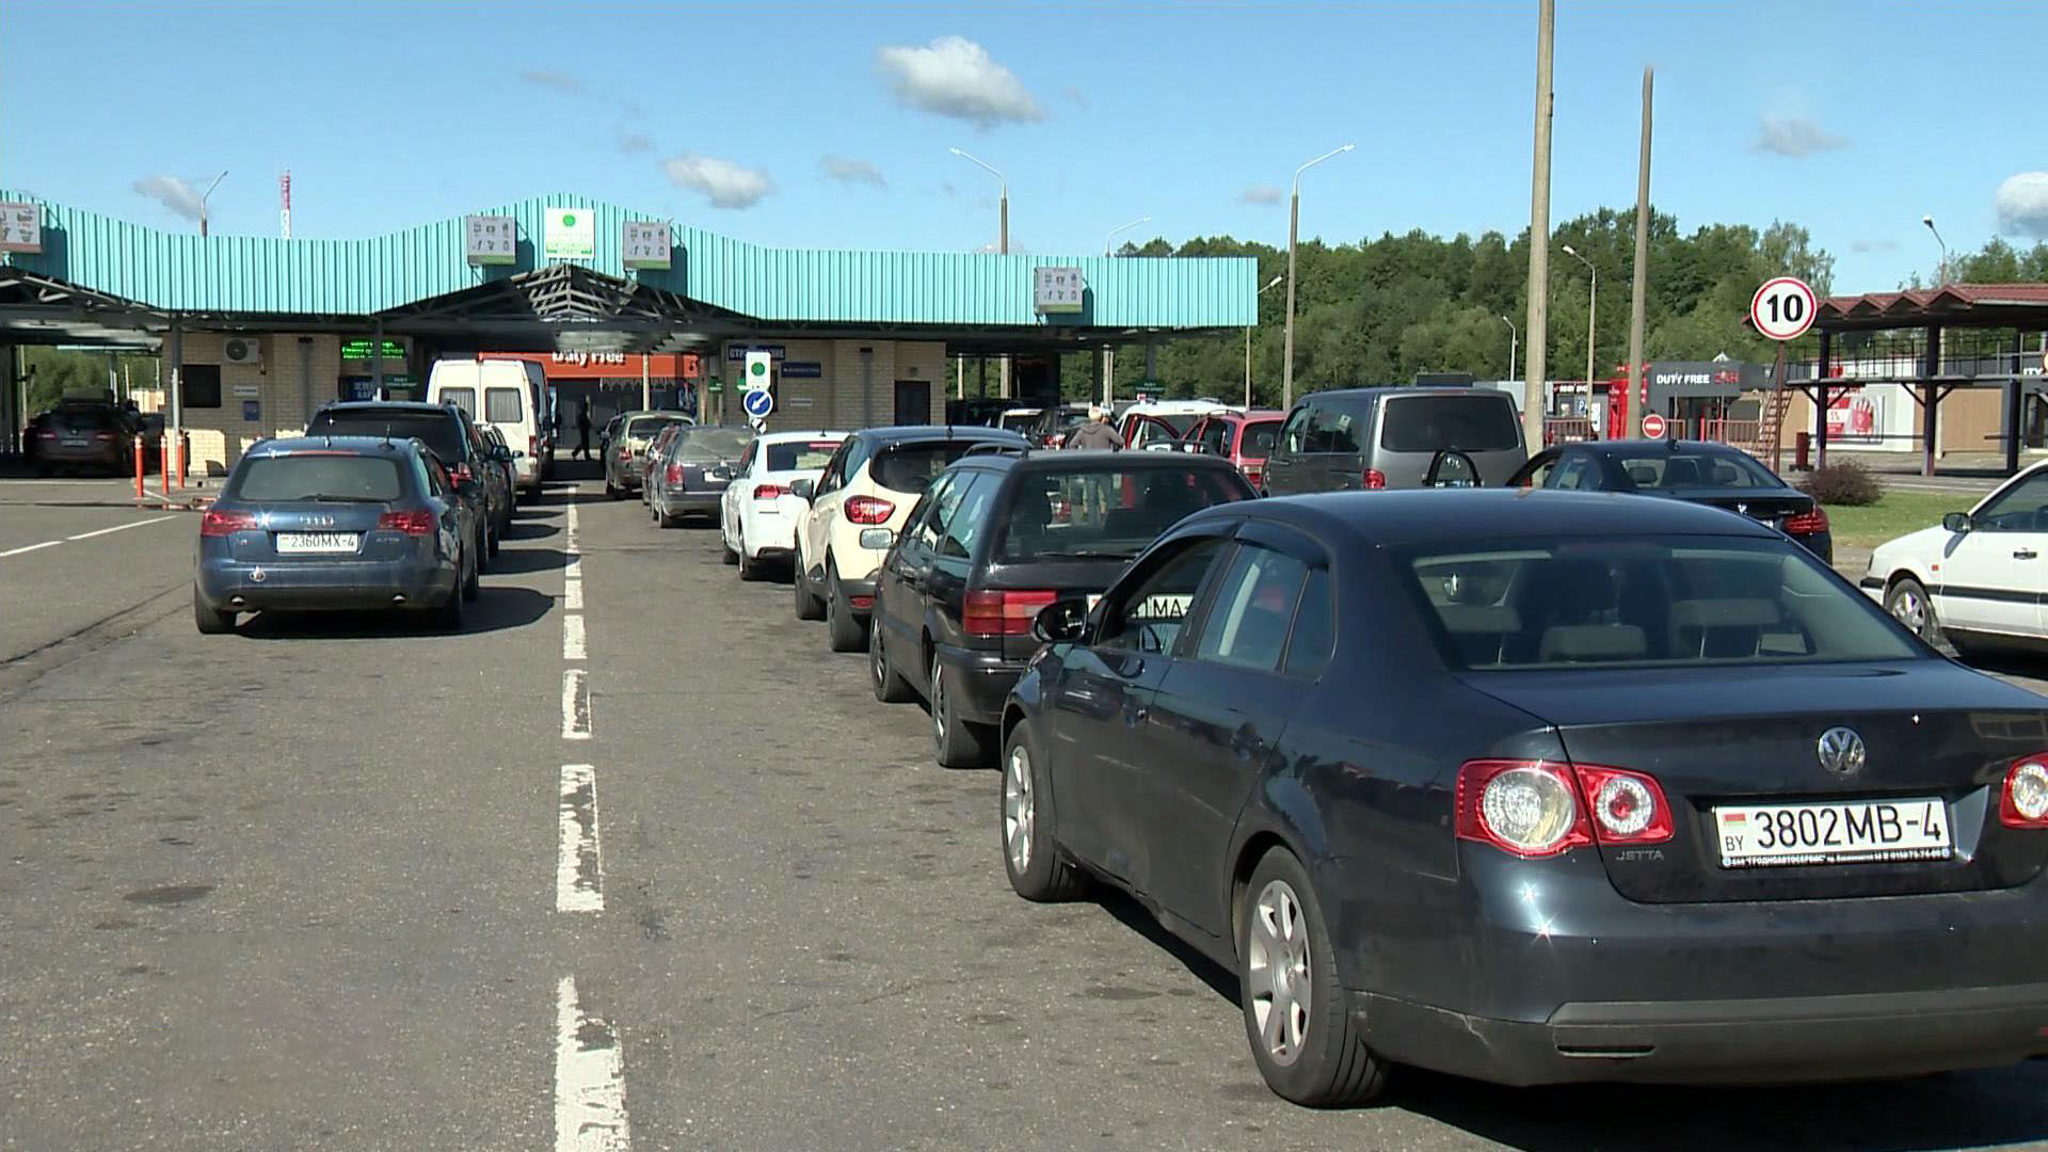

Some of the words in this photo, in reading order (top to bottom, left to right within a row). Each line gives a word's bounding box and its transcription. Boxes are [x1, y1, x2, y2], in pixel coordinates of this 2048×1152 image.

[1767, 294, 1804, 323] 10
[1656, 374, 1682, 384] DUTY
[1684, 374, 1710, 384] FREE
[290, 532, 355, 548] 2360MX-4
[1754, 803, 1942, 849] 3802MB-4
[1725, 835, 1744, 851] BY
[1615, 849, 1665, 861] JETTA
